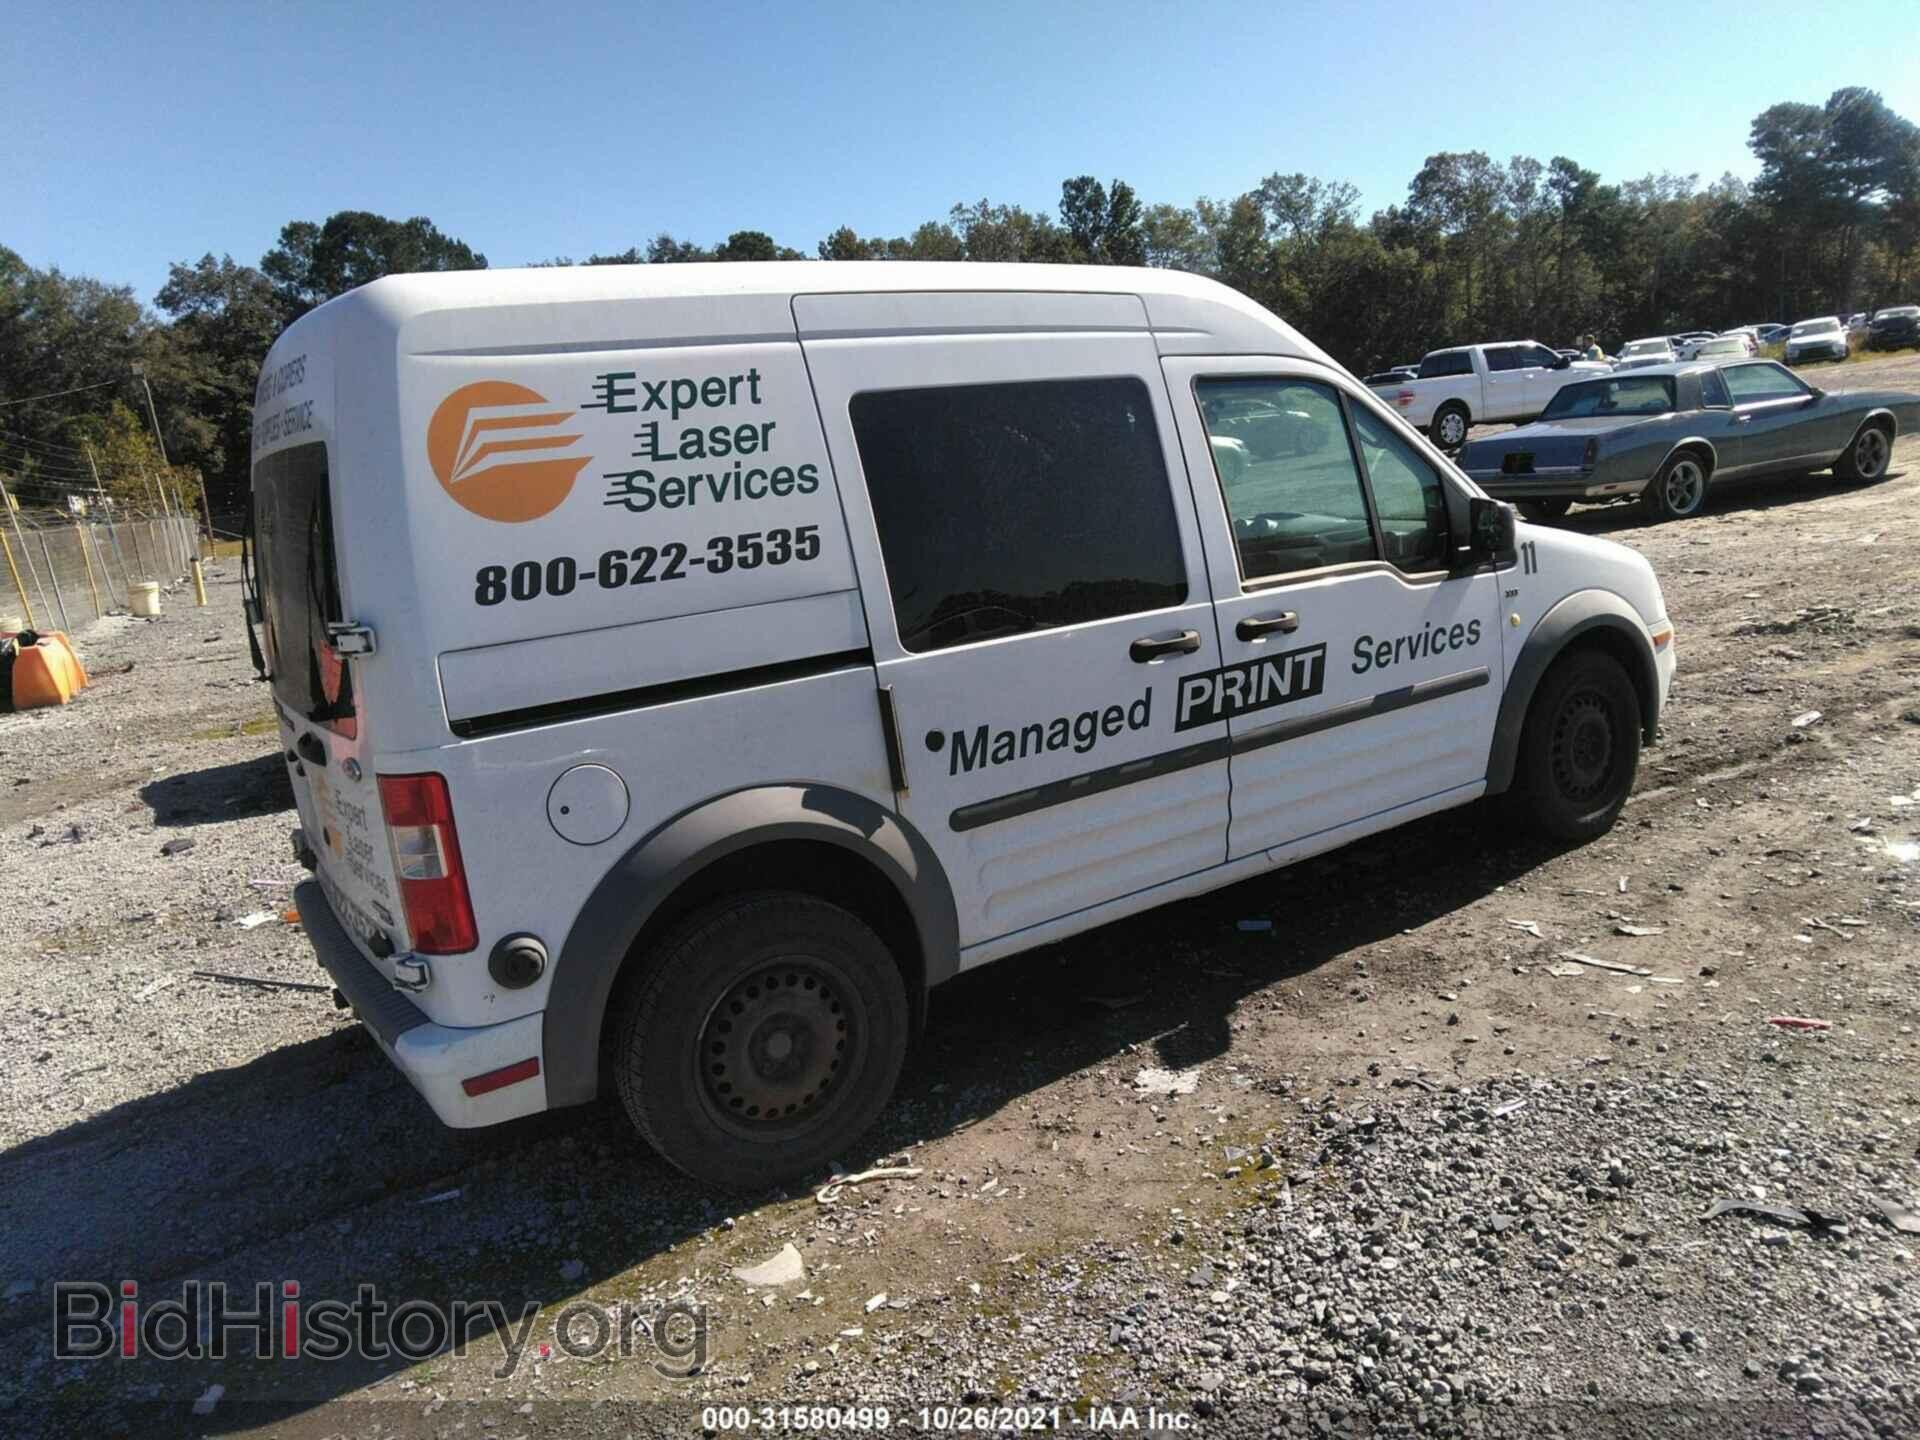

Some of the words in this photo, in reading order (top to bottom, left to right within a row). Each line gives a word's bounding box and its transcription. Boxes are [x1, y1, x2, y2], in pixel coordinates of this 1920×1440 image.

[603, 368, 762, 420] Expert
[650, 421, 776, 462] Laser
[622, 461, 820, 513] Services
[474, 524, 821, 606] 800-622-3535
[1520, 540, 1537, 575] 11
[948, 686, 1153, 776] Managed
[1179, 647, 1326, 721] PRINT
[1351, 617, 1482, 674] Services
